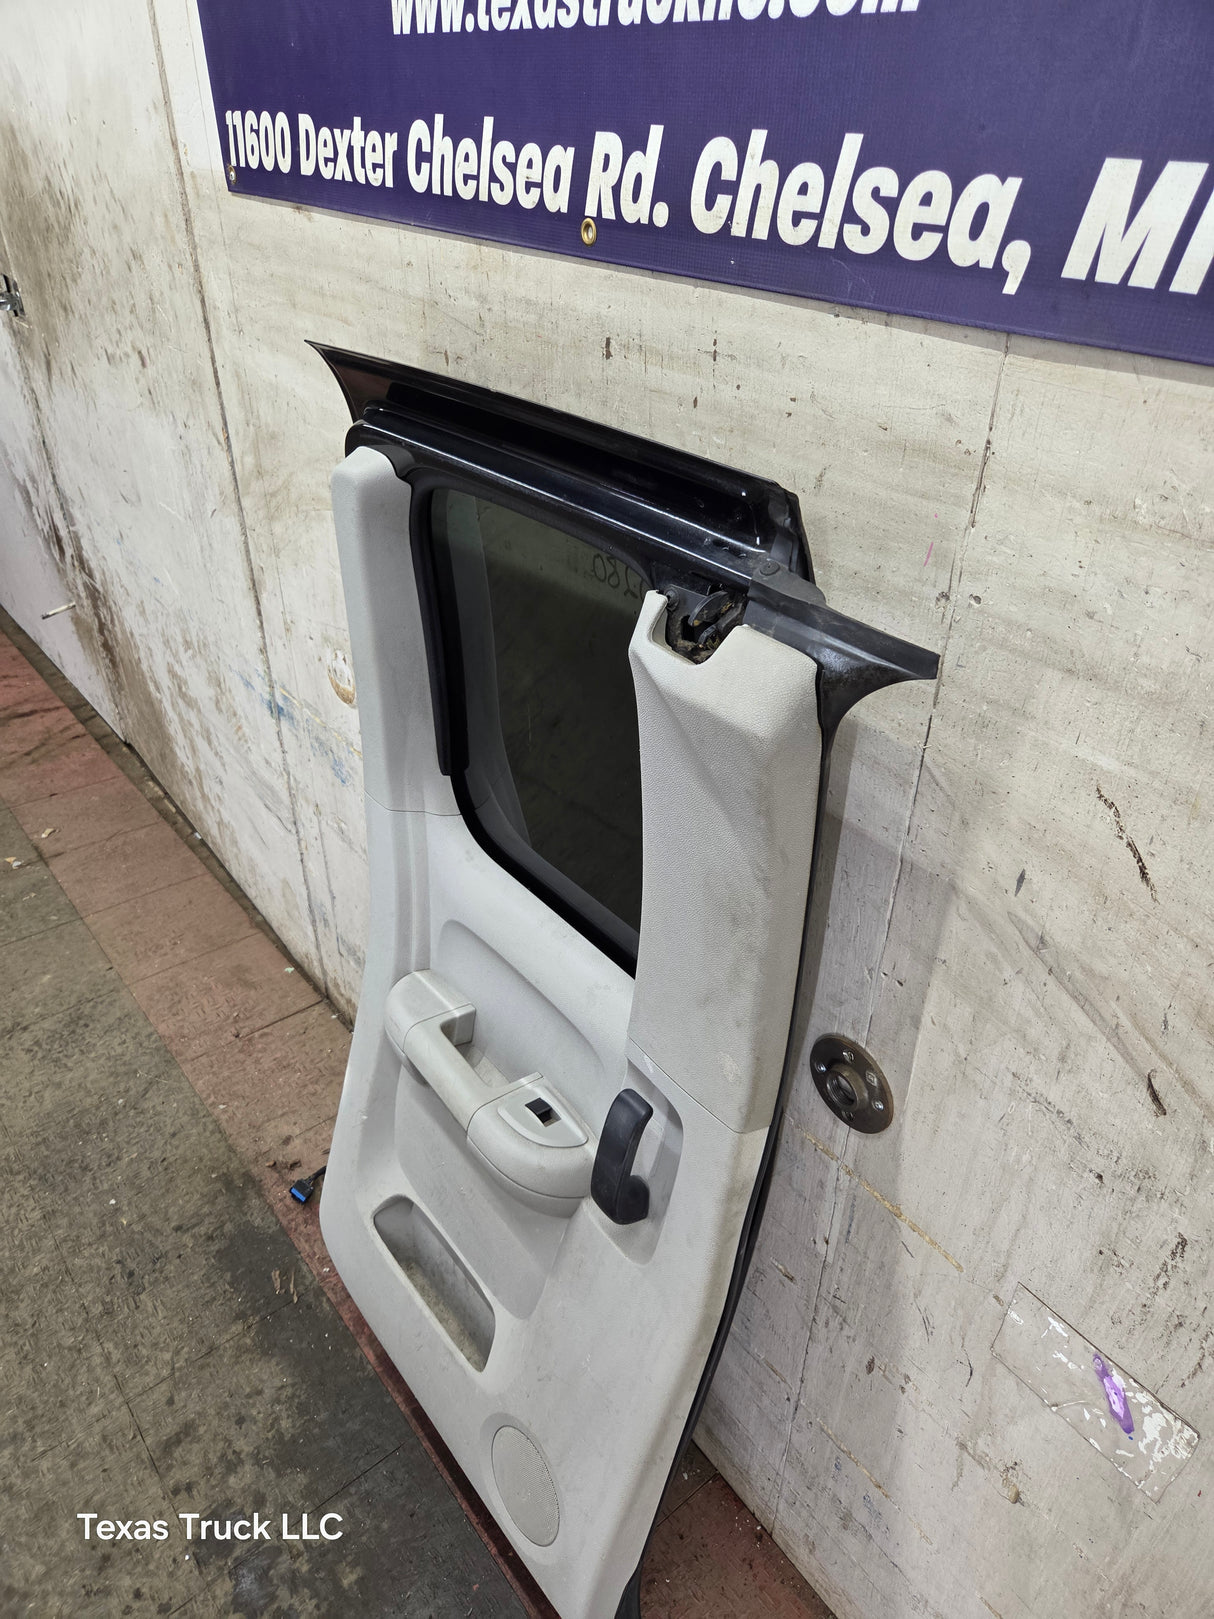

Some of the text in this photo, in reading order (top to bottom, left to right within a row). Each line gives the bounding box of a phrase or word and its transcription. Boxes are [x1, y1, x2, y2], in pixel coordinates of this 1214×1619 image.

[225, 110, 292, 174] 11600
[298, 114, 397, 188] Dexter
[407, 114, 575, 213] Chelsea
[584, 125, 669, 228] Rd.
[690, 129, 1031, 295] Chelsea,
